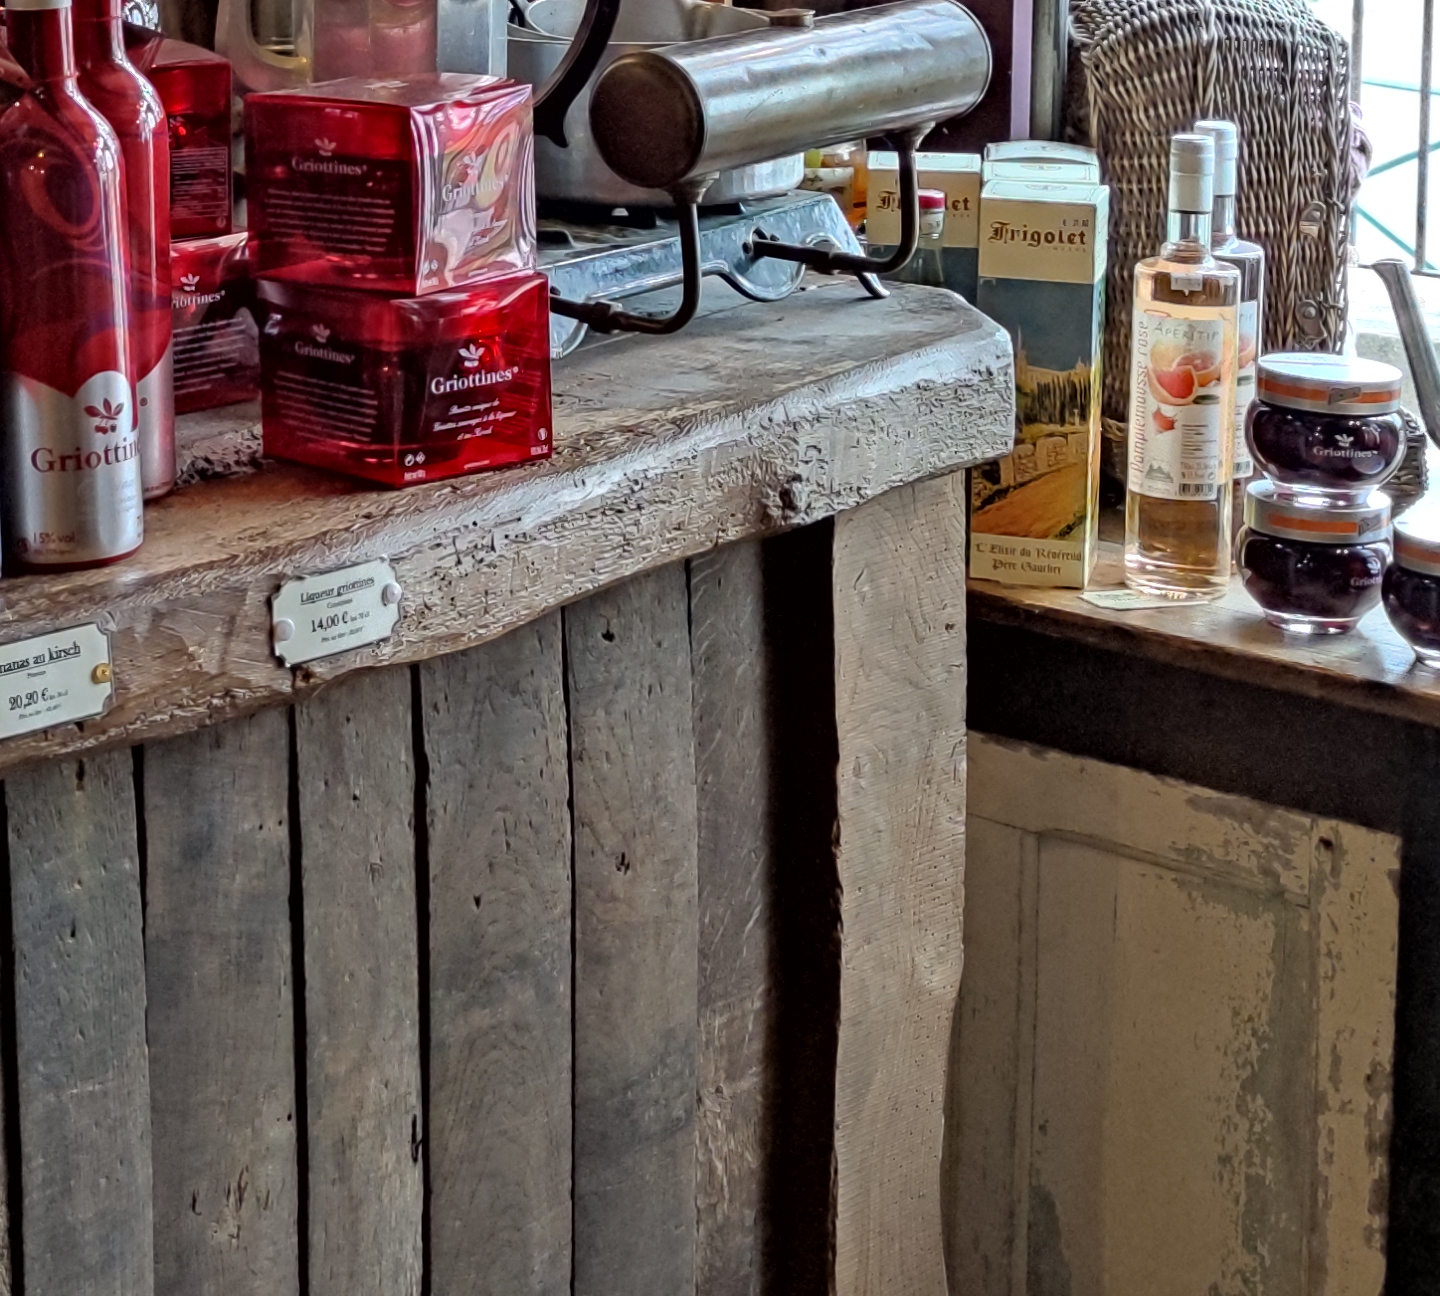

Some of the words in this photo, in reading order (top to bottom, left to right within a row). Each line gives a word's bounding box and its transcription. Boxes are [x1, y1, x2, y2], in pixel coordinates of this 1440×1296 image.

[987, 220, 1088, 247] Frigolet
[1138, 320, 1149, 355] rose
[1154, 321, 1221, 342] APÉRITIF
[991, 558, 1019, 573] Père
[300, 587, 335, 604] Liqueur
[311, 613, 341, 634] 14,00
[33, 652, 47, 666] au
[48, 641, 82, 664] kirsch
[8, 689, 40, 712] 20,20
[40, 686, 50, 703] €
